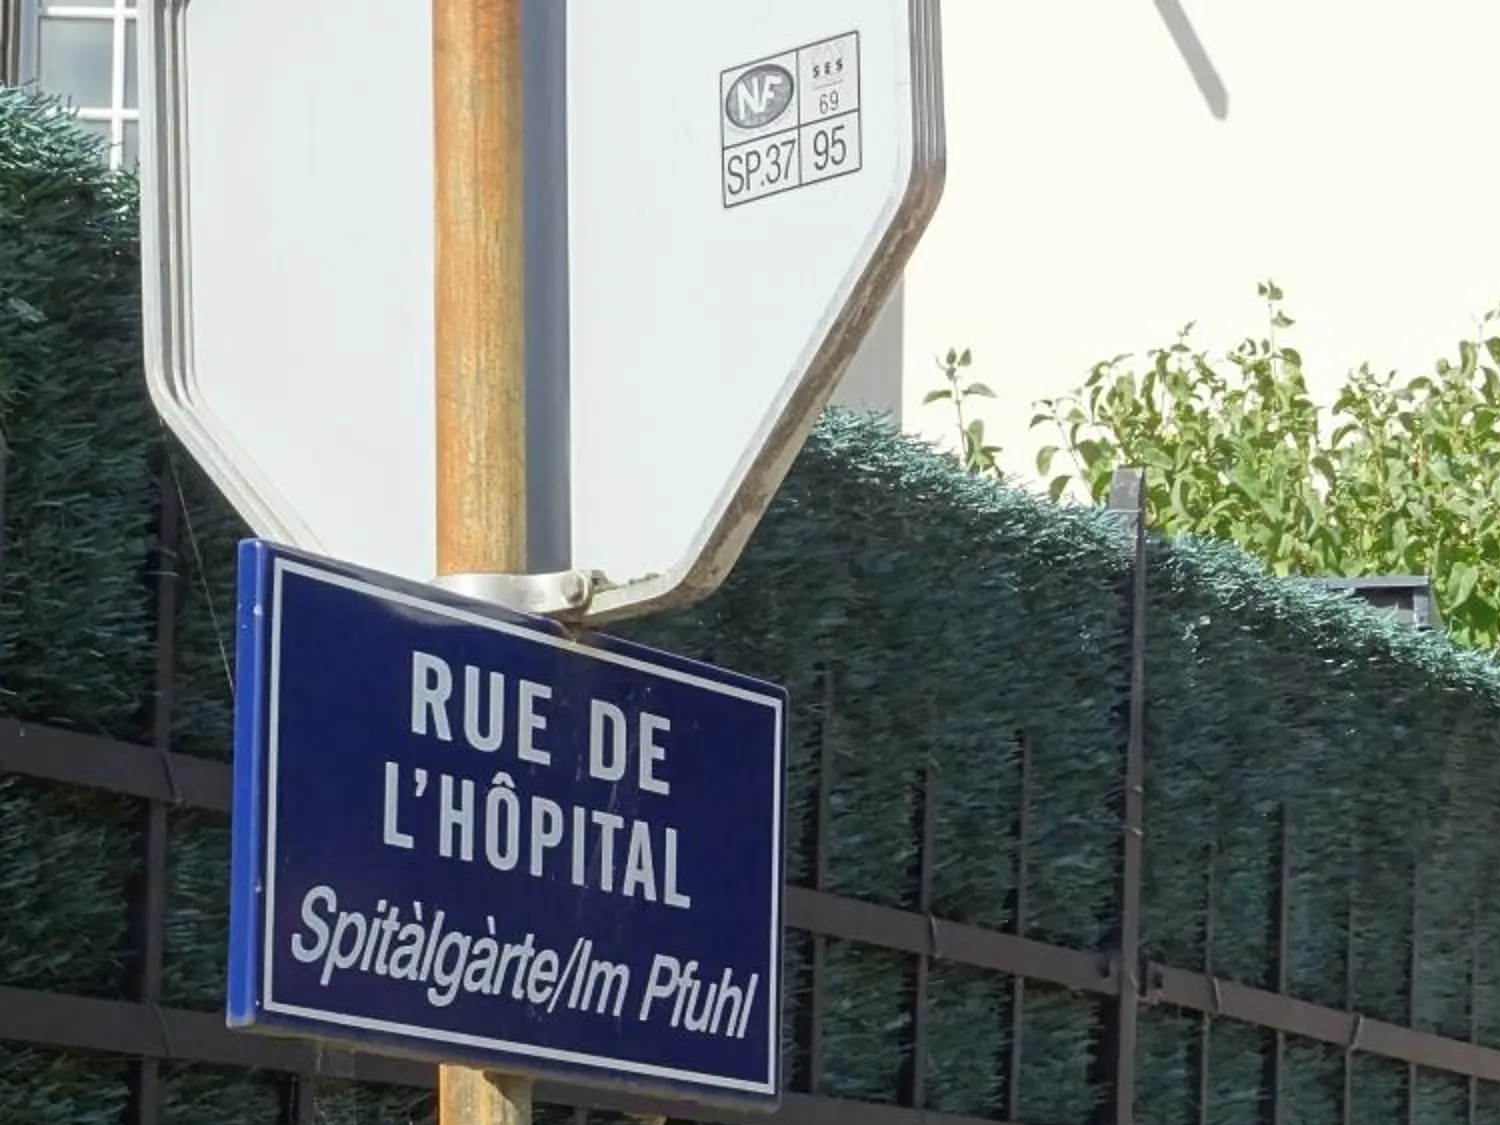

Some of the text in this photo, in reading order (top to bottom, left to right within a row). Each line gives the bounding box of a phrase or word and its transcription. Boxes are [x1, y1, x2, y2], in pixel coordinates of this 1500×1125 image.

[736, 75, 783, 121] NF
[819, 89, 839, 115] 69
[727, 139, 797, 195] SP.37
[813, 124, 847, 171] 95
[411, 651, 671, 796] RUE DE
[382, 761, 691, 909] L'HÔPITAL
[639, 953, 760, 1039] Pfuhl
